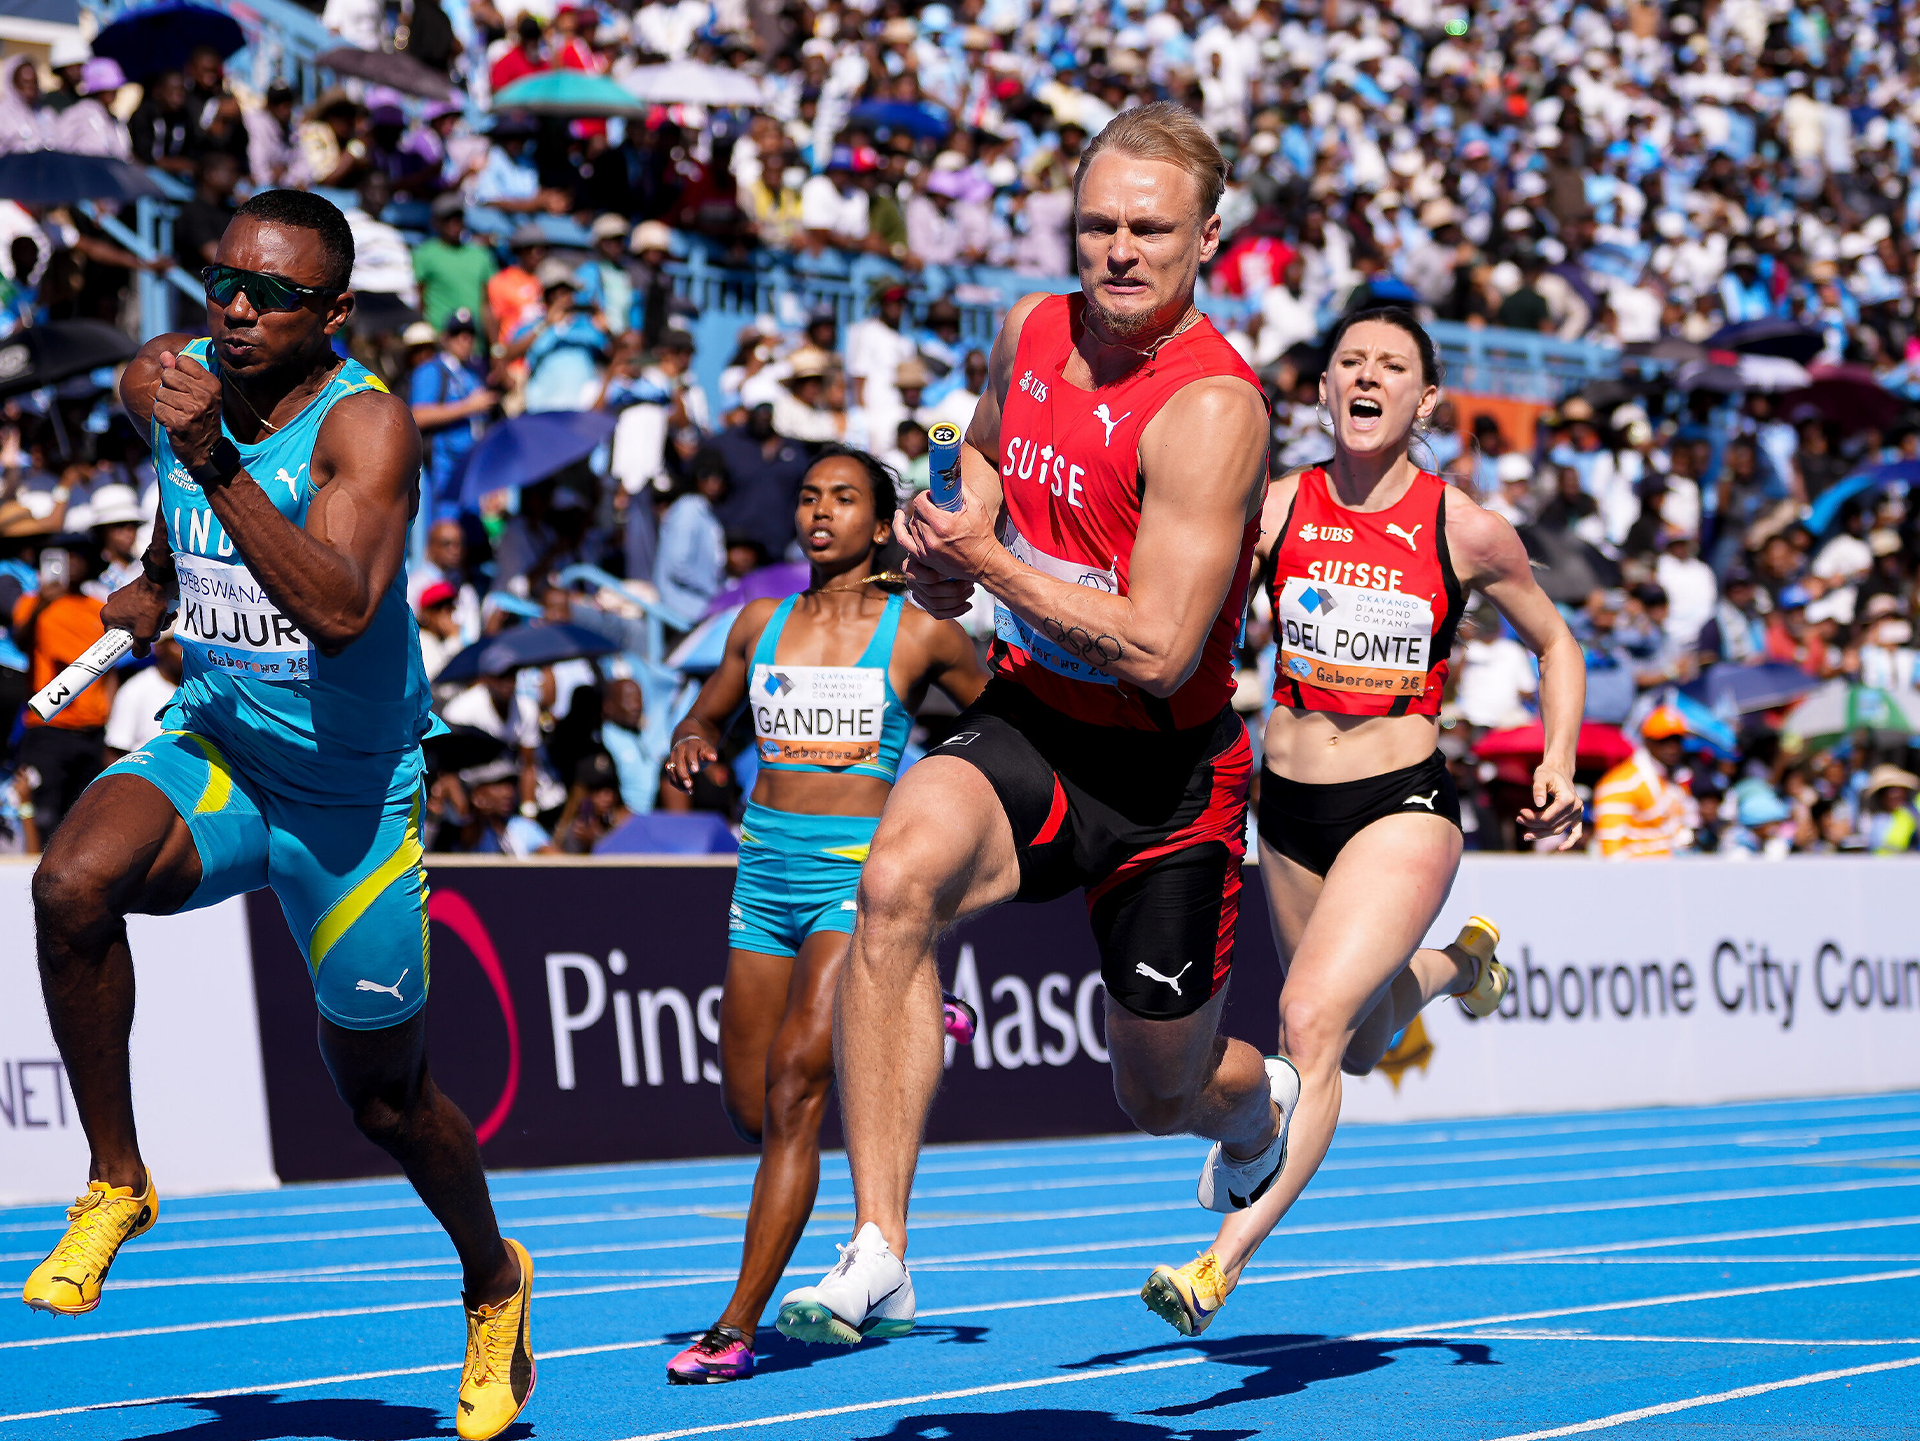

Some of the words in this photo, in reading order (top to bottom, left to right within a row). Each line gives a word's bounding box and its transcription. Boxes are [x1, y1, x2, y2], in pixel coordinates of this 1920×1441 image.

[935, 430, 951, 440] 32
[167, 472, 198, 492] ATHLETICS
[1320, 526, 1354, 543] UBS
[179, 569, 269, 604] DEBSWANA
[1356, 604, 1411, 619] DIAMOND
[1358, 594, 1419, 610] OKAVANGO
[184, 598, 301, 647] KUJUR
[1355, 614, 1410, 629] COMPANY
[1286, 619, 1327, 656] DEL
[1333, 629, 1422, 665] PONTE
[207, 649, 280, 674] Gaborone
[286, 657, 309, 673] 26
[812, 682, 863, 690] DIAMOND
[1316, 667, 1394, 689] Gaborone
[1401, 676, 1420, 690] 26
[47, 682, 71, 706] 3
[812, 692, 864, 700] COMPANY
[757, 706, 874, 736] GANDHE
[784, 745, 851, 760] Gaborone
[1455, 945, 1695, 1022] aborone
[1710, 939, 1799, 1031] City
